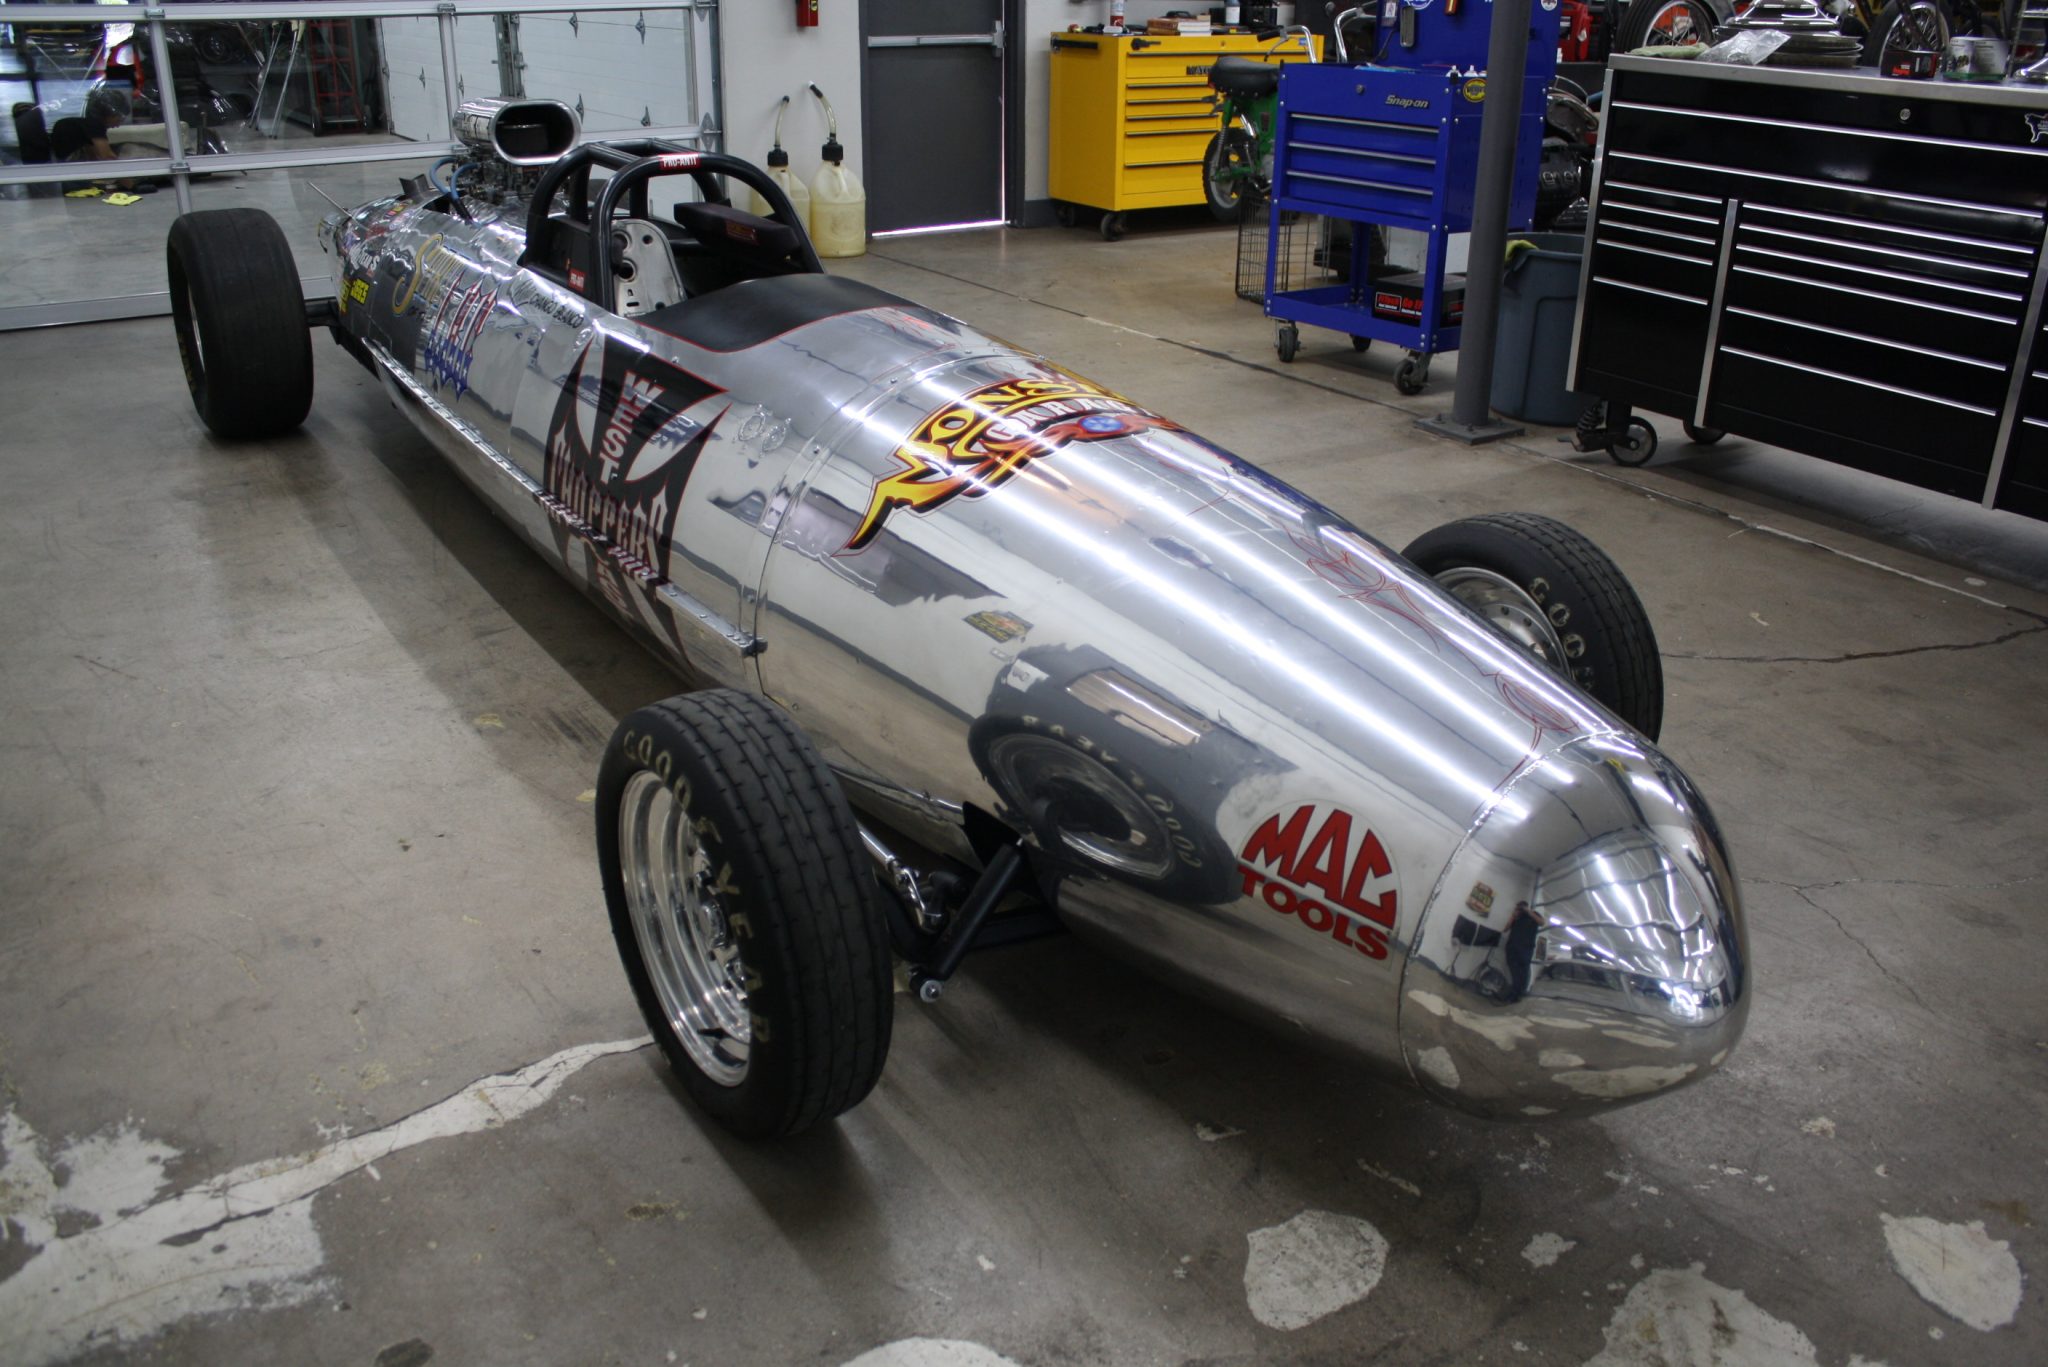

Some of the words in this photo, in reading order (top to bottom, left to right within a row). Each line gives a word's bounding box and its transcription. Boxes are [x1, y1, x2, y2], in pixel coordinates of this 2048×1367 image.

[1385, 94, 1428, 109] Snap-on
[600, 370, 665, 484] WEST
[550, 428, 669, 582] CHOPPERS
[623, 729, 771, 1043] GOODYEAR
[1237, 864, 1390, 960] TOOLS
[1241, 804, 1397, 930] MAC
